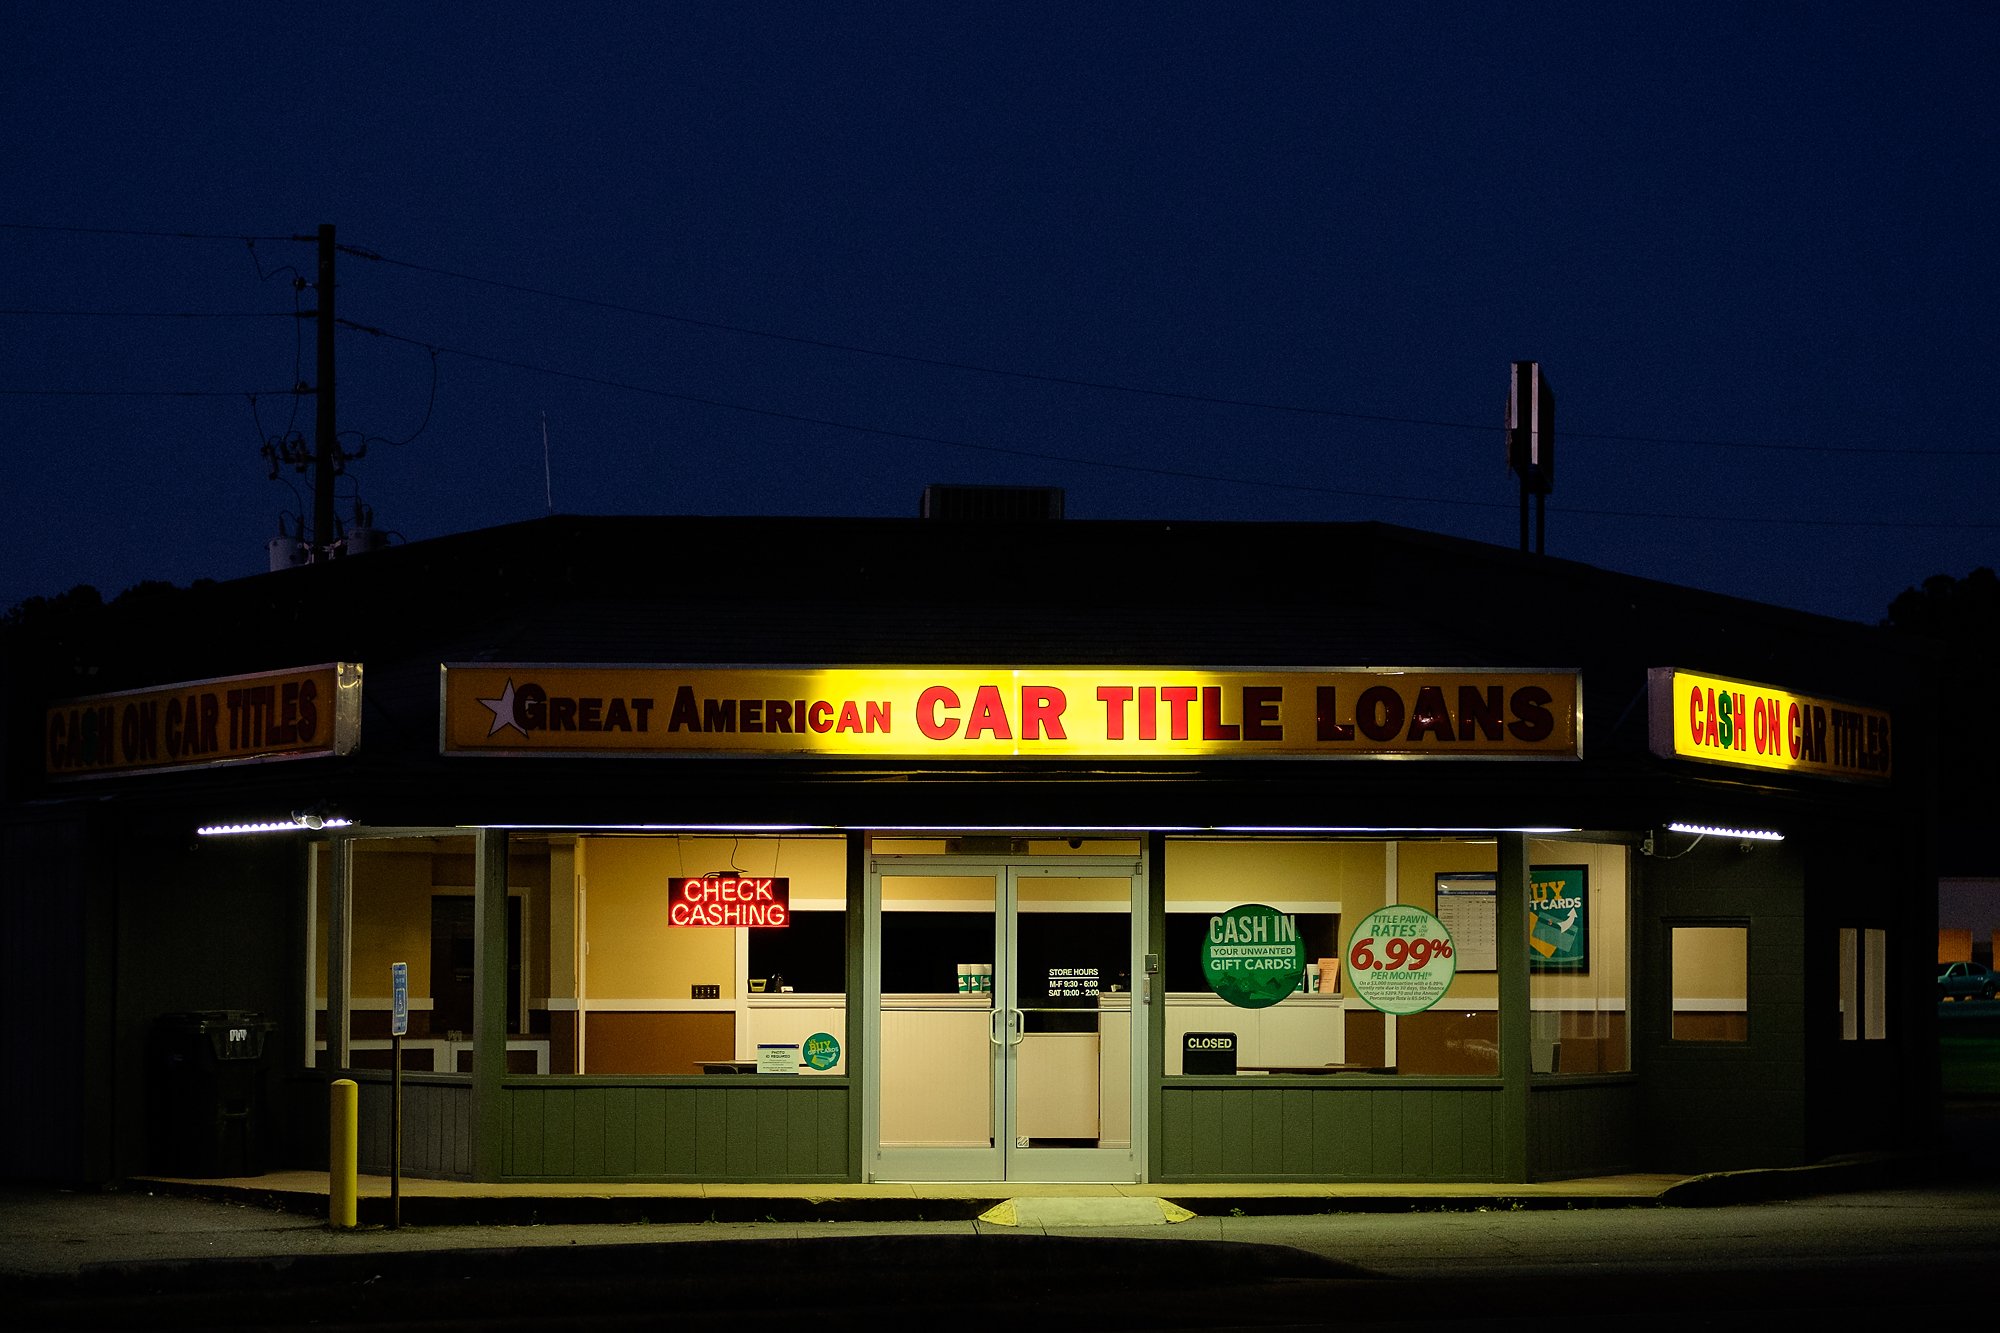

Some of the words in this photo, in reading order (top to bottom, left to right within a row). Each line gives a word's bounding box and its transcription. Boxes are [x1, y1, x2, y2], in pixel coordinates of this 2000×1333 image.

[513, 682, 654, 733] GREAT
[668, 685, 892, 735] AMERICAN
[916, 685, 1067, 741] CAR
[1097, 685, 1284, 741] TITLE
[1316, 685, 1555, 742] LOANS
[122, 701, 157, 763] ON
[165, 692, 219, 758] CAR
[227, 679, 318, 751] TITLES
[1754, 696, 1781, 756] ON
[1788, 702, 1828, 762] CAR
[1831, 706, 1890, 773] TITLES
[684, 880, 774, 902] CHECK
[1530, 880, 1566, 903] UY
[1541, 897, 1582, 910] CARDS
[671, 903, 785, 926] CASHING
[1374, 915, 1398, 923] TITLE
[1400, 915, 1428, 923] PAWN
[1209, 915, 1268, 944] CASH
[1274, 914, 1296, 942] IN
[1371, 924, 1416, 936] RATES
[1213, 948, 1239, 956] YOUR
[1241, 947, 1293, 956] UNWANTED
[1351, 938, 1453, 971] 6.99%
[1210, 959, 1241, 971] GIFT
[1244, 958, 1297, 970] CARDS!
[1049, 968, 1073, 976] STORE
[1073, 968, 1099, 976] HOURS
[1370, 971, 1389, 980] PER
[1049, 980, 1063, 988] M-F
[1083, 980, 1099, 988] 6:00
[1048, 989, 1062, 997] SAT
[1062, 989, 1080, 997] 10:00
[1085, 989, 1100, 997] 2:00
[808, 1040, 832, 1052] BUY
[1187, 1037, 1233, 1049] CLOSED
